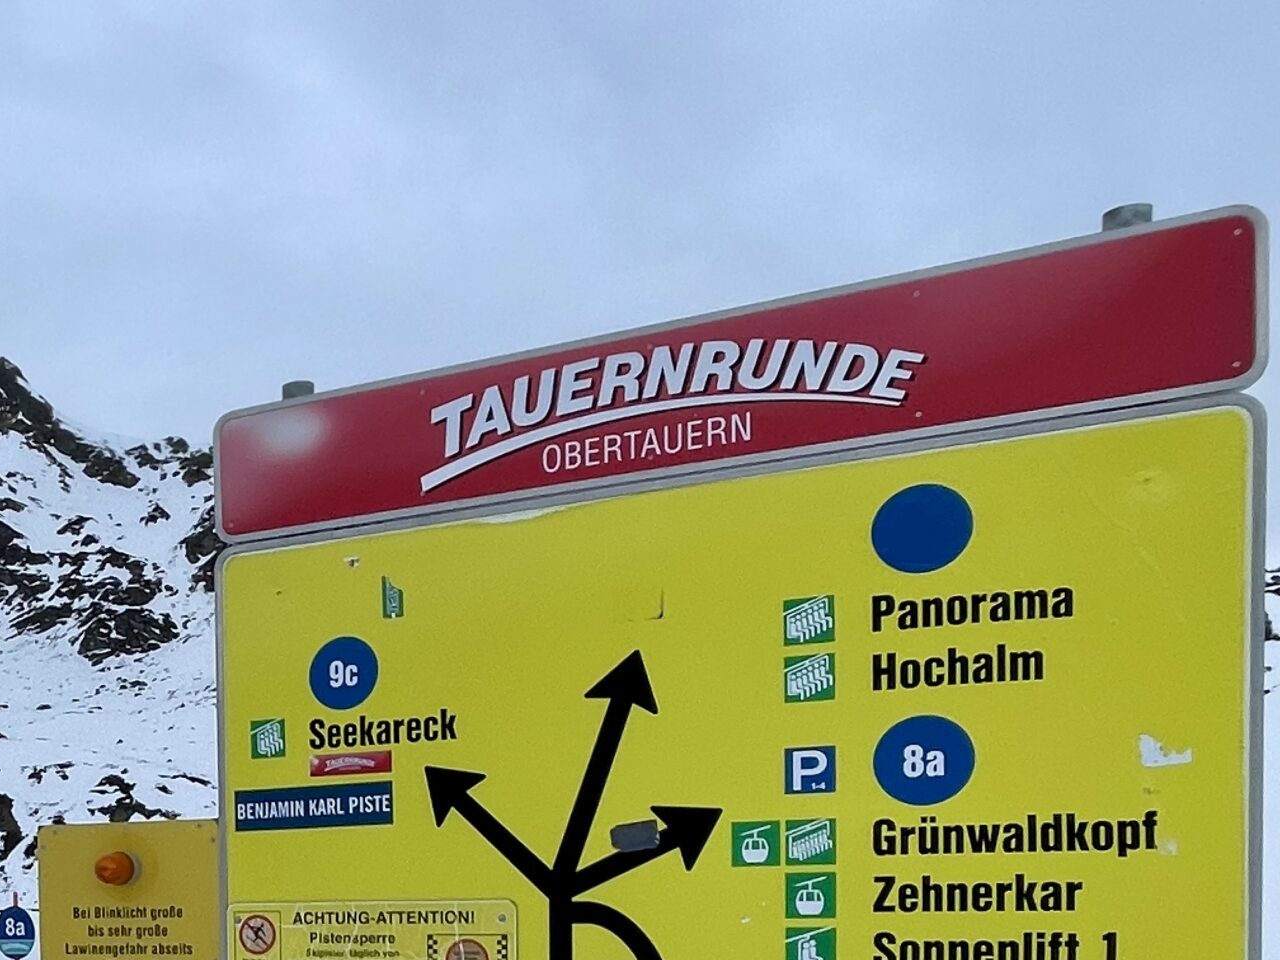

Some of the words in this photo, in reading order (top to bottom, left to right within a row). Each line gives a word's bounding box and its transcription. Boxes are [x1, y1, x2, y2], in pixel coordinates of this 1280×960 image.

[430, 339, 925, 459] TAUERNRUNDE
[542, 412, 752, 473] OBERTAUERN
[871, 587, 1074, 632] Panorama
[328, 660, 359, 688] 9c
[872, 644, 1044, 691] Hochalm
[309, 708, 457, 749] Seekareck
[793, 750, 827, 791] P
[902, 744, 945, 778] 8a
[237, 798, 305, 820] BENJAMIN
[309, 797, 345, 817] KARL
[348, 794, 391, 814] PISTE
[872, 811, 1158, 857] Grünwaldkopf
[872, 873, 1084, 913] Zehnerkar
[5, 917, 26, 936] 8a
[73, 907, 91, 919] Bei
[94, 906, 147, 919] Blinklicht
[150, 906, 183, 920] große
[293, 911, 475, 925] ACHTUNG-ATTENTION!
[88, 925, 104, 937] bis
[108, 925, 132, 937] sehr
[136, 924, 168, 939] große
[310, 932, 396, 946] Pistensperre
[65, 943, 148, 957] Lawinengefahr
[151, 943, 193, 955] abseits
